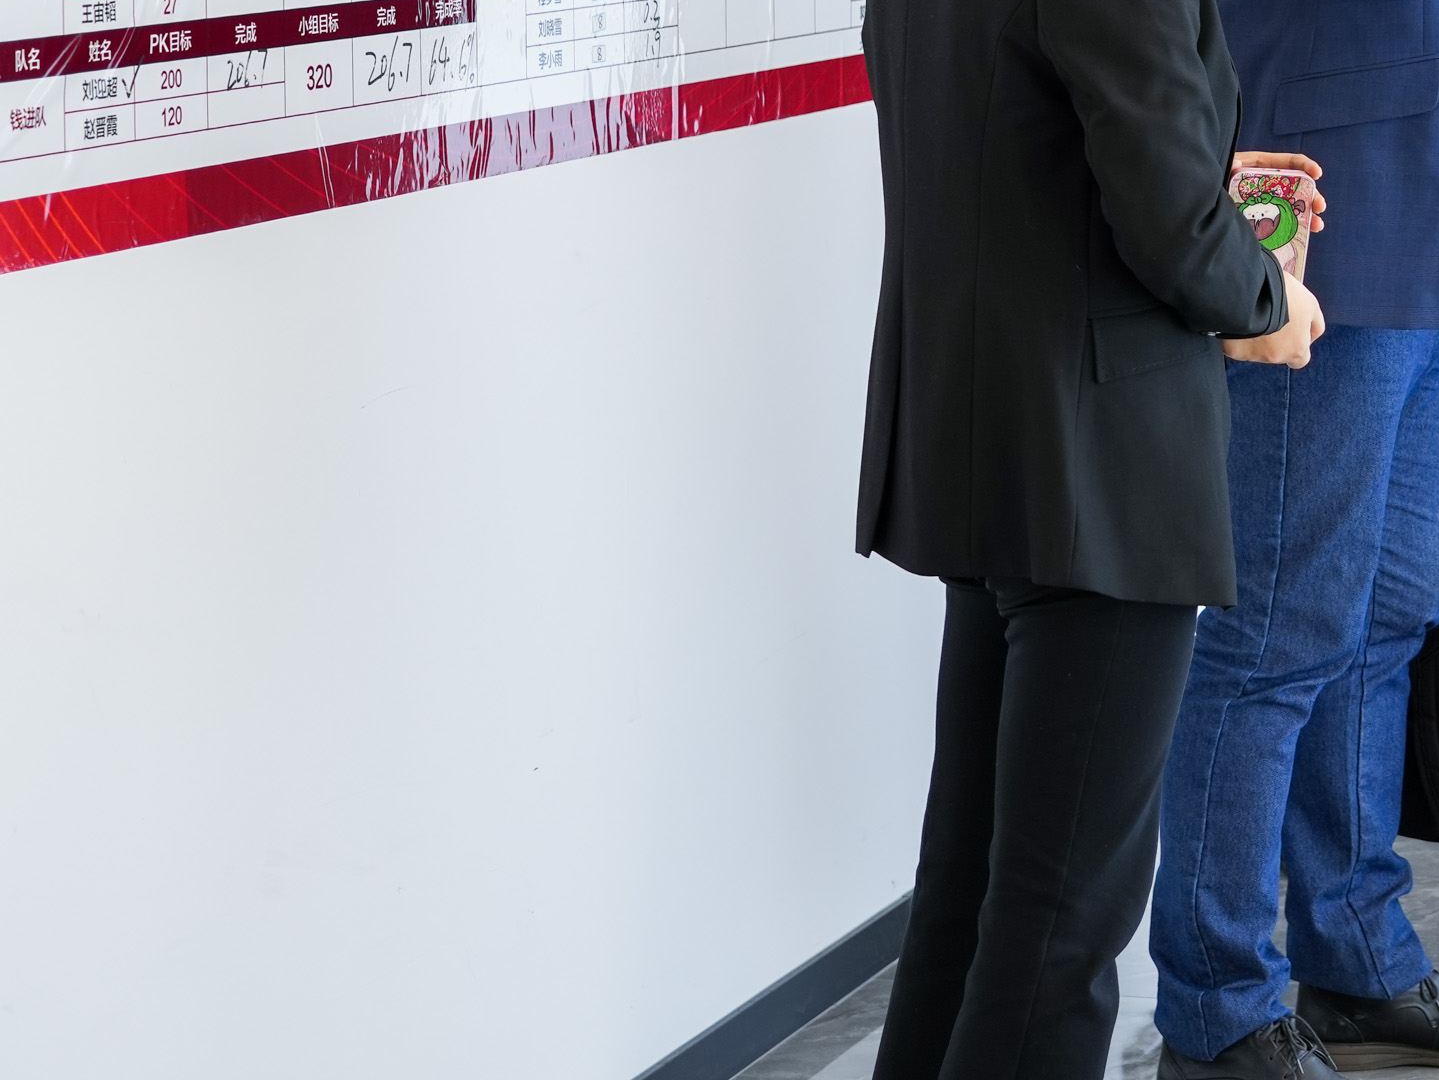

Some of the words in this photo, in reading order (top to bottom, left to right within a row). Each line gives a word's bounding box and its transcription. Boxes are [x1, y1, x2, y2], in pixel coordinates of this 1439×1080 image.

[299, 12, 339, 35] 小组目标
[377, 6, 396, 26] 完成
[150, 30, 192, 54] PK目标
[234, 23, 257, 45] 完成
[15, 48, 41, 73] 队名
[88, 39, 112, 62] 姓名
[161, 68, 182, 91] 200
[306, 63, 333, 90] 320
[82, 76, 118, 102] 刘迎超
[10, 103, 47, 131] 钱进队
[83, 114, 118, 141] 赵晋霞
[161, 105, 182, 128] 120
